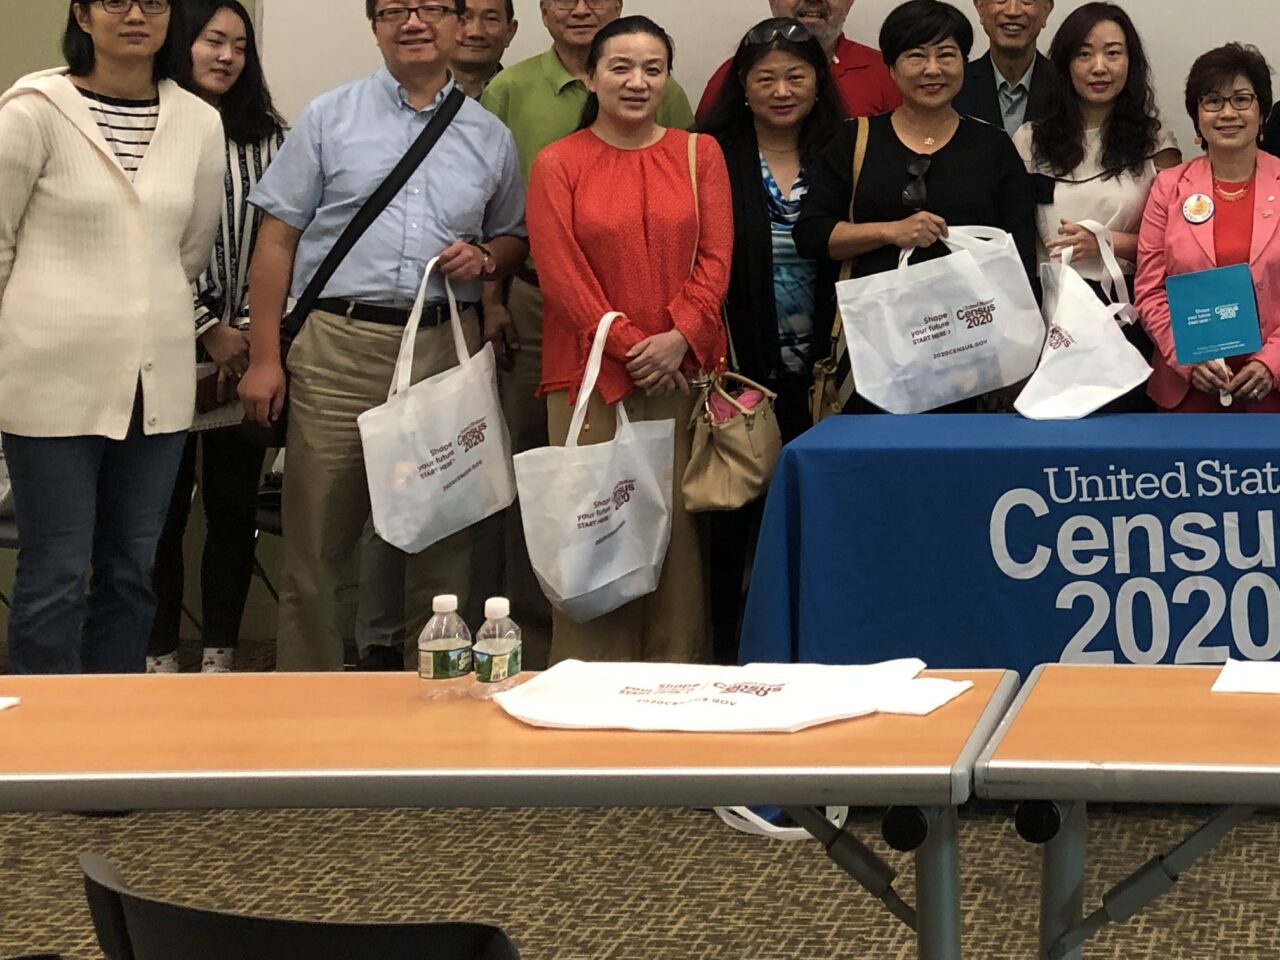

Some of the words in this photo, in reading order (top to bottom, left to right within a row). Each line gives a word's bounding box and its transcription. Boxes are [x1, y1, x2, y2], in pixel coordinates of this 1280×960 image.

[924, 312, 948, 324] Shape
[956, 304, 996, 320] Census
[966, 312, 993, 329] 2020
[911, 328, 926, 338] your
[928, 321, 950, 332] future
[912, 336, 930, 345] START
[457, 422, 487, 446] Census
[430, 442, 452, 456] Shape
[463, 432, 484, 453] 2020
[417, 461, 434, 472] your
[436, 450, 454, 464] future
[1044, 462, 1190, 504] United
[577, 512, 594, 522] your
[577, 520, 596, 529] START
